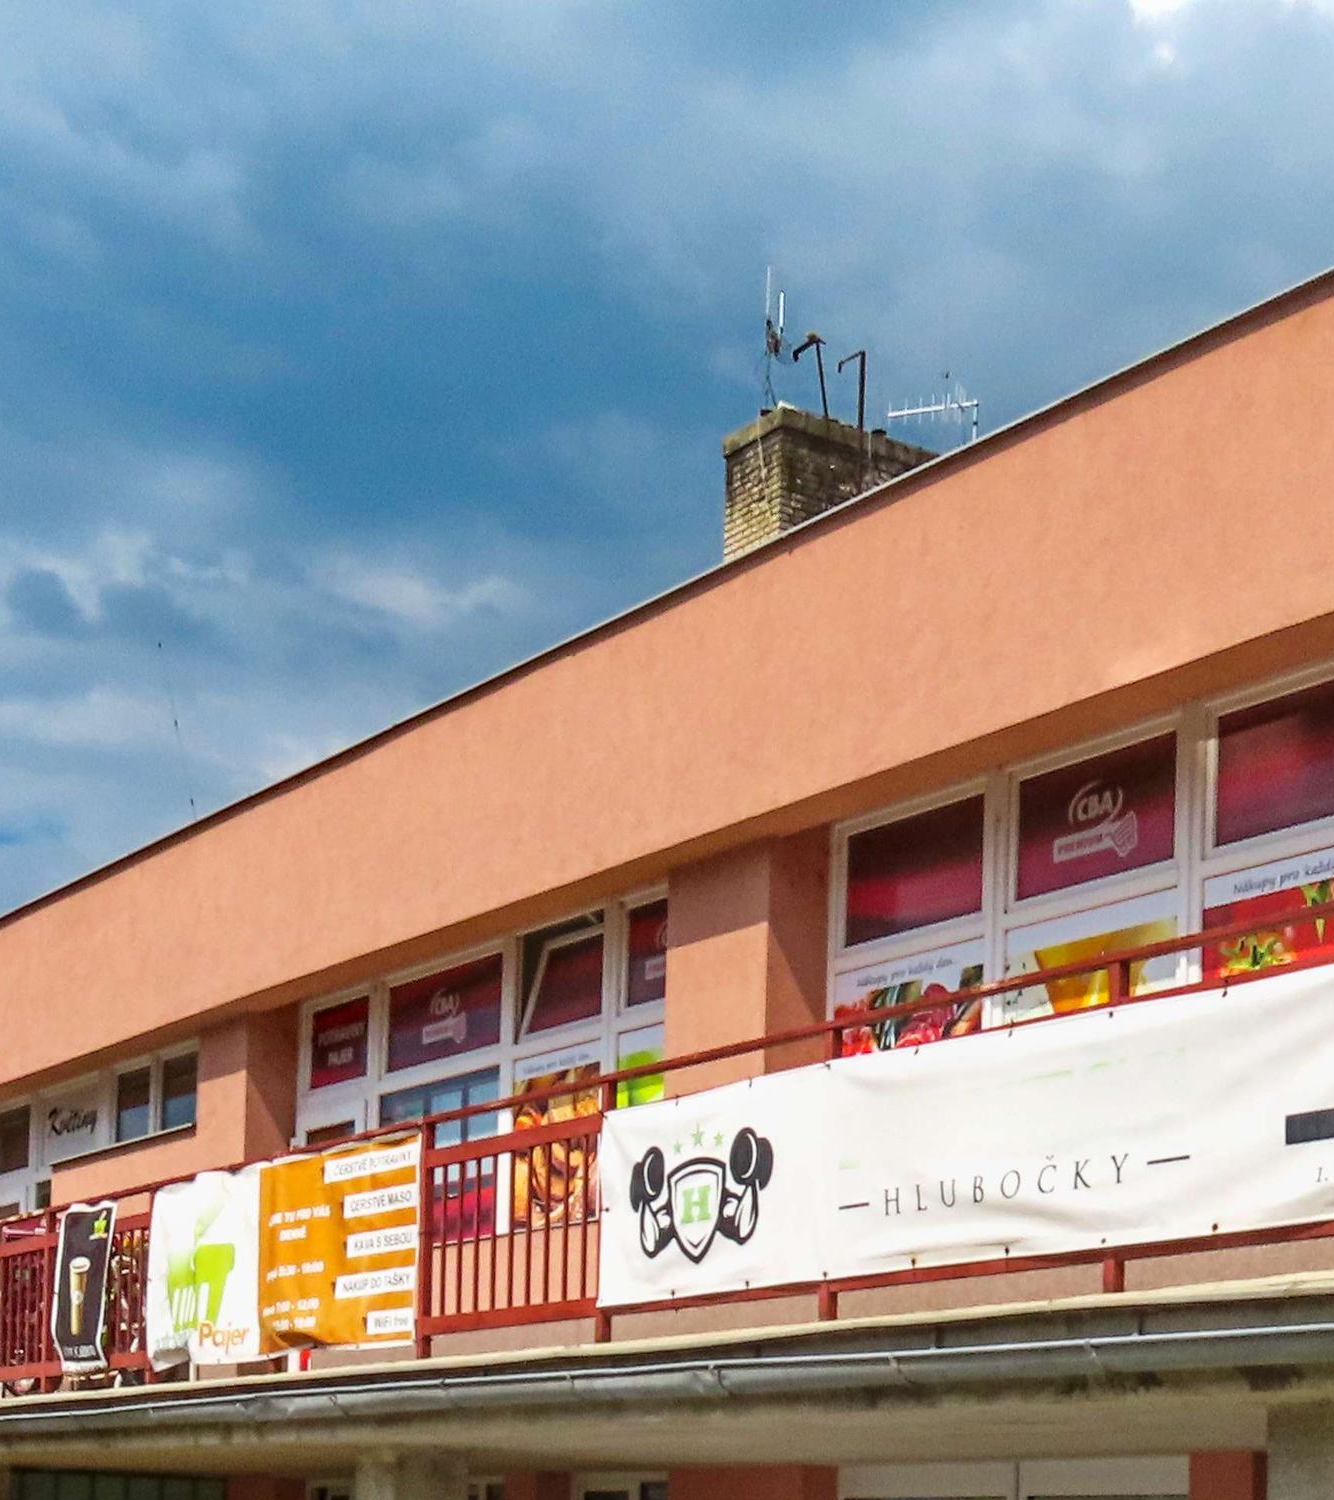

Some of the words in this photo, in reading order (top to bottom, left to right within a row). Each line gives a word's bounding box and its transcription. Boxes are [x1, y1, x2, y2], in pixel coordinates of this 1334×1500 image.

[1075, 788, 1116, 822] CBA
[1279, 870, 1300, 886] pro
[387, 1190, 413, 1205] MASO
[883, 1153, 1130, 1217] HLUBOČKY
[680, 1185, 712, 1225] H
[198, 1321, 250, 1354] Pajer
